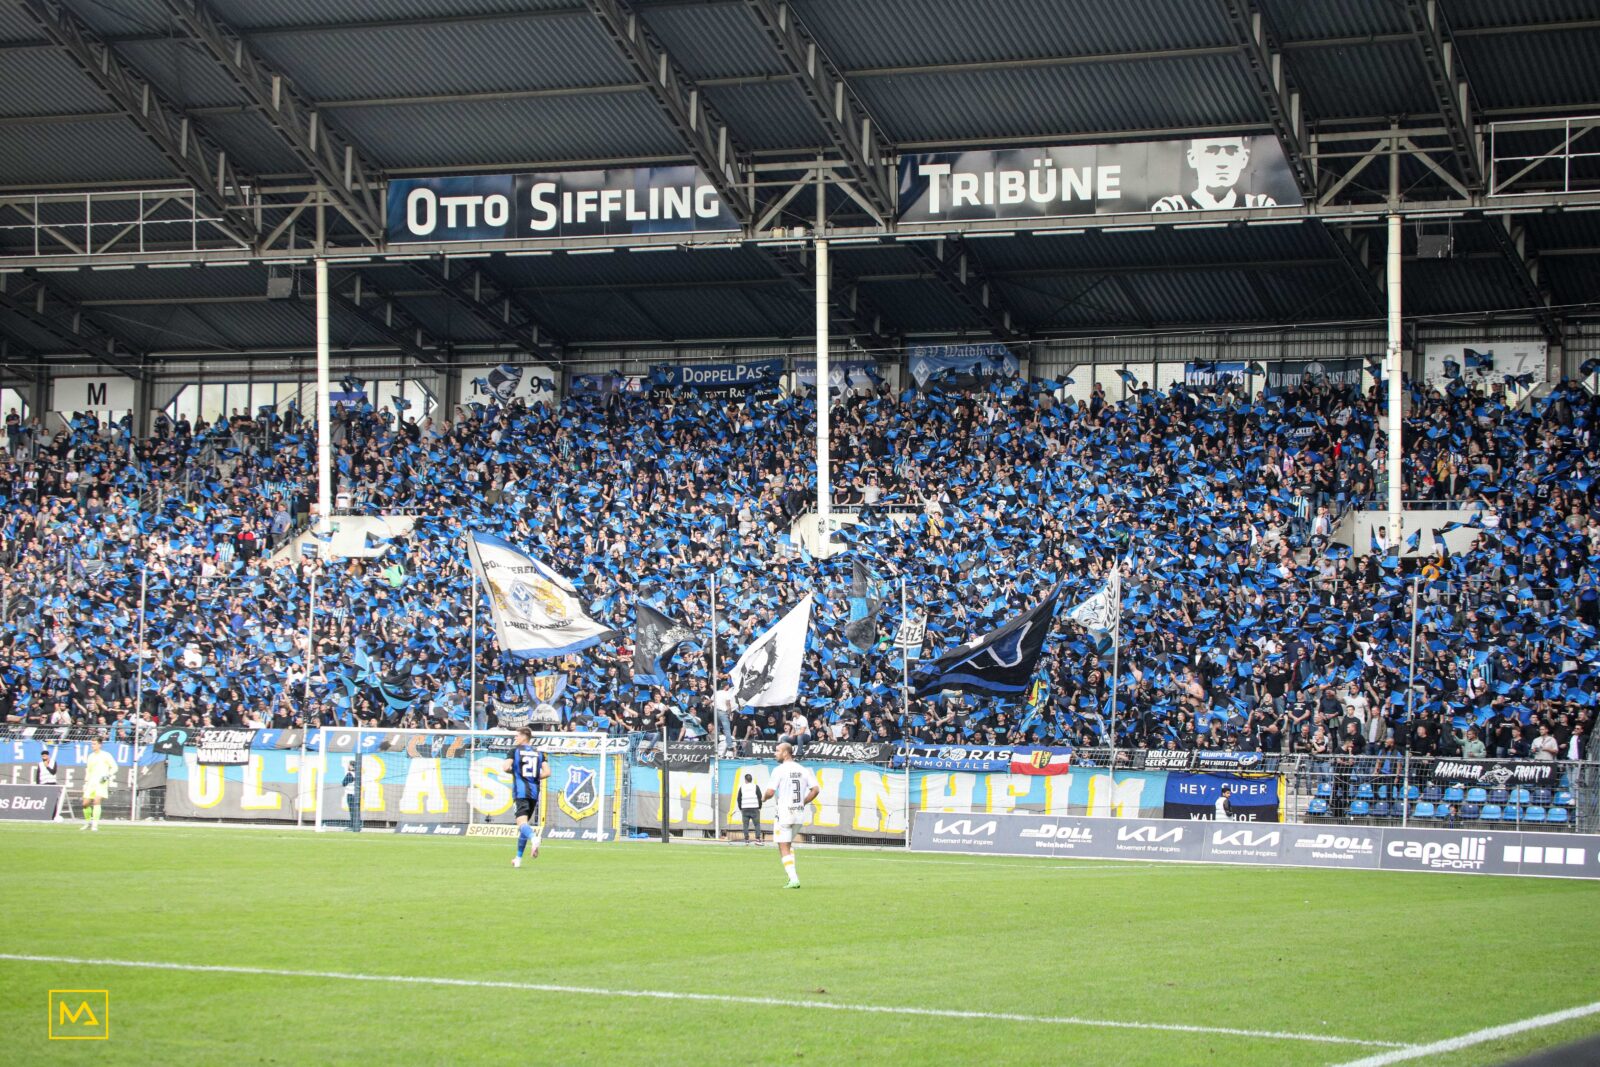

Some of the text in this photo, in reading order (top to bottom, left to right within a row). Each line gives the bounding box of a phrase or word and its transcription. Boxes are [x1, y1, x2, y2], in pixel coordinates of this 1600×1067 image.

[530, 182, 720, 231] SIFFLING
[918, 158, 1121, 214] TRIBÜNE
[87, 382, 107, 405] M
[805, 743, 853, 757] POWER
[1148, 750, 1191, 758] KOLLEKTIV
[522, 756, 538, 778] 21
[1168, 759, 1188, 767] ACHT
[1434, 761, 1484, 778] BARACKLER
[791, 779, 801, 804] 3
[11, 795, 48, 810] Büro!
[400, 823, 462, 836] bwin bwin
[548, 828, 576, 839] bwin
[1035, 840, 1074, 849] Weinheim
[1387, 836, 1486, 865] capelli
[1311, 851, 1354, 859] Weinheim
[1431, 859, 1485, 869] SPORT
